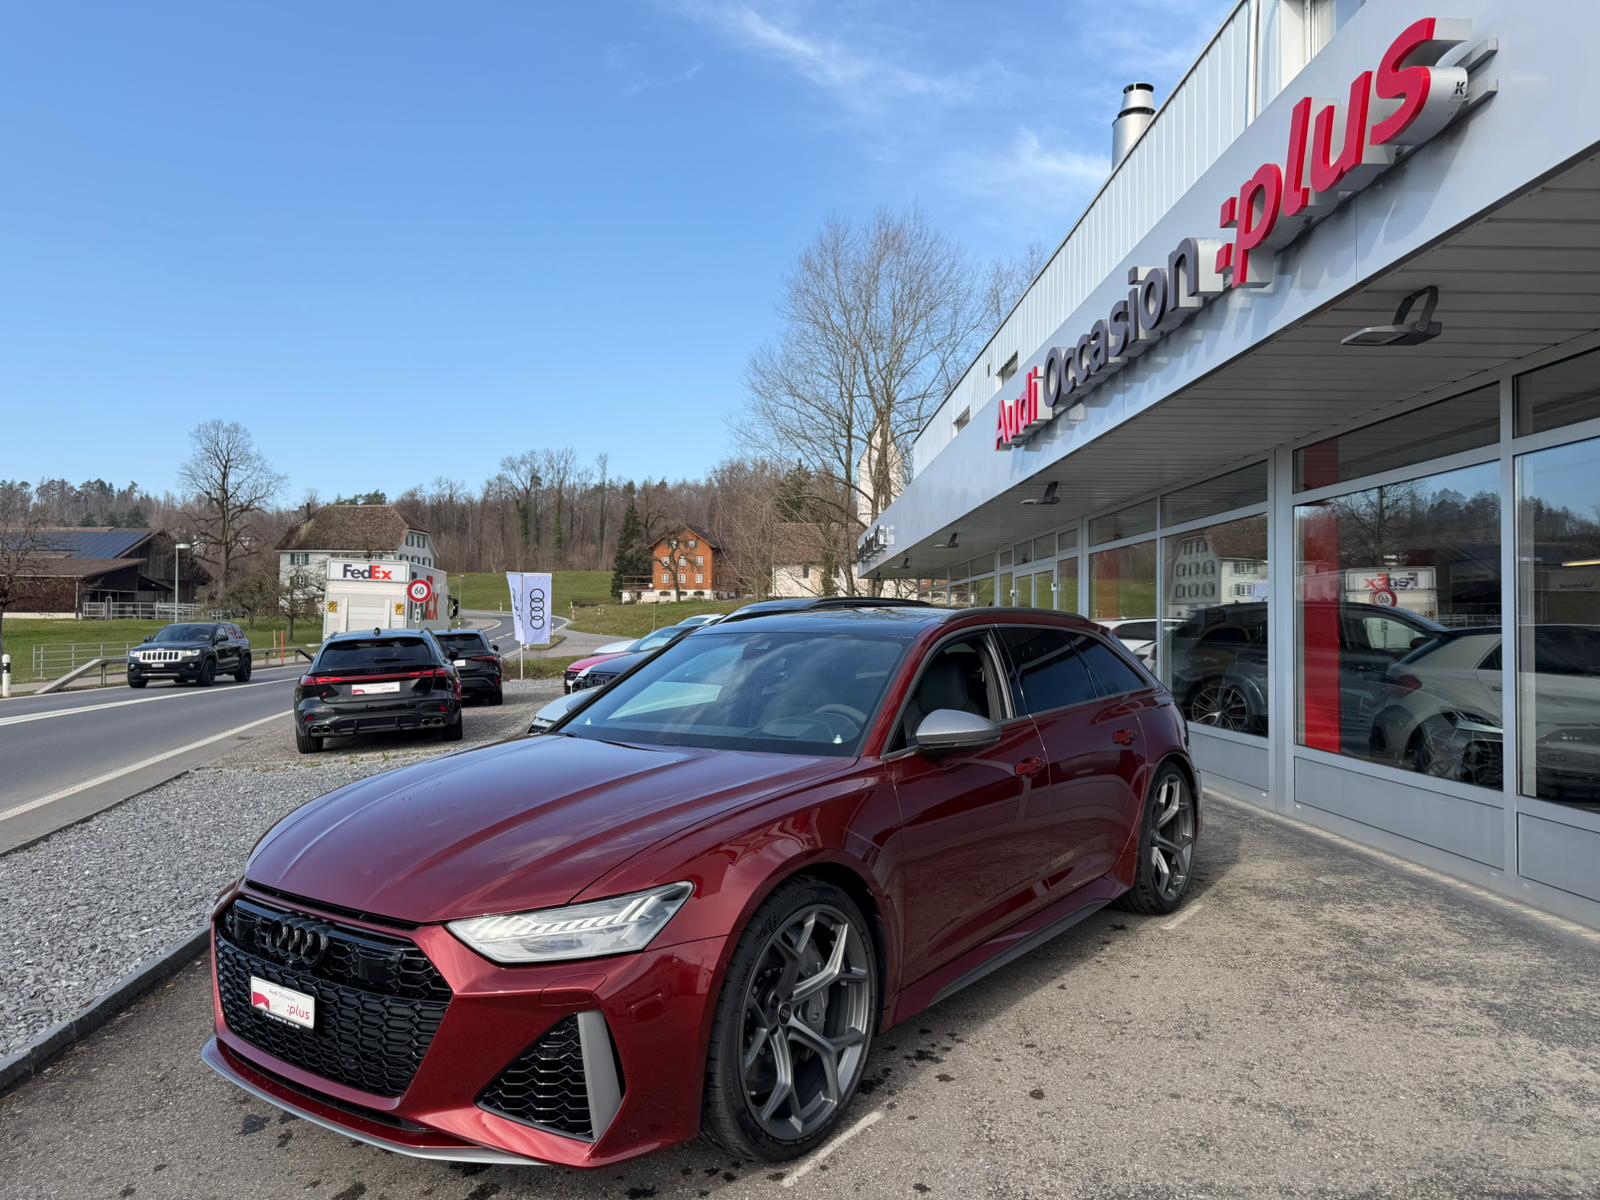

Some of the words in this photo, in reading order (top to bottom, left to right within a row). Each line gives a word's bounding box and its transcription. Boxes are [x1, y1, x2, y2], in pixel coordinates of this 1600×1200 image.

[995, 366, 1038, 450] Audi
[1043, 237, 1200, 408] Occasion
[342, 563, 393, 580] FedEx
[414, 586, 425, 595] 60
